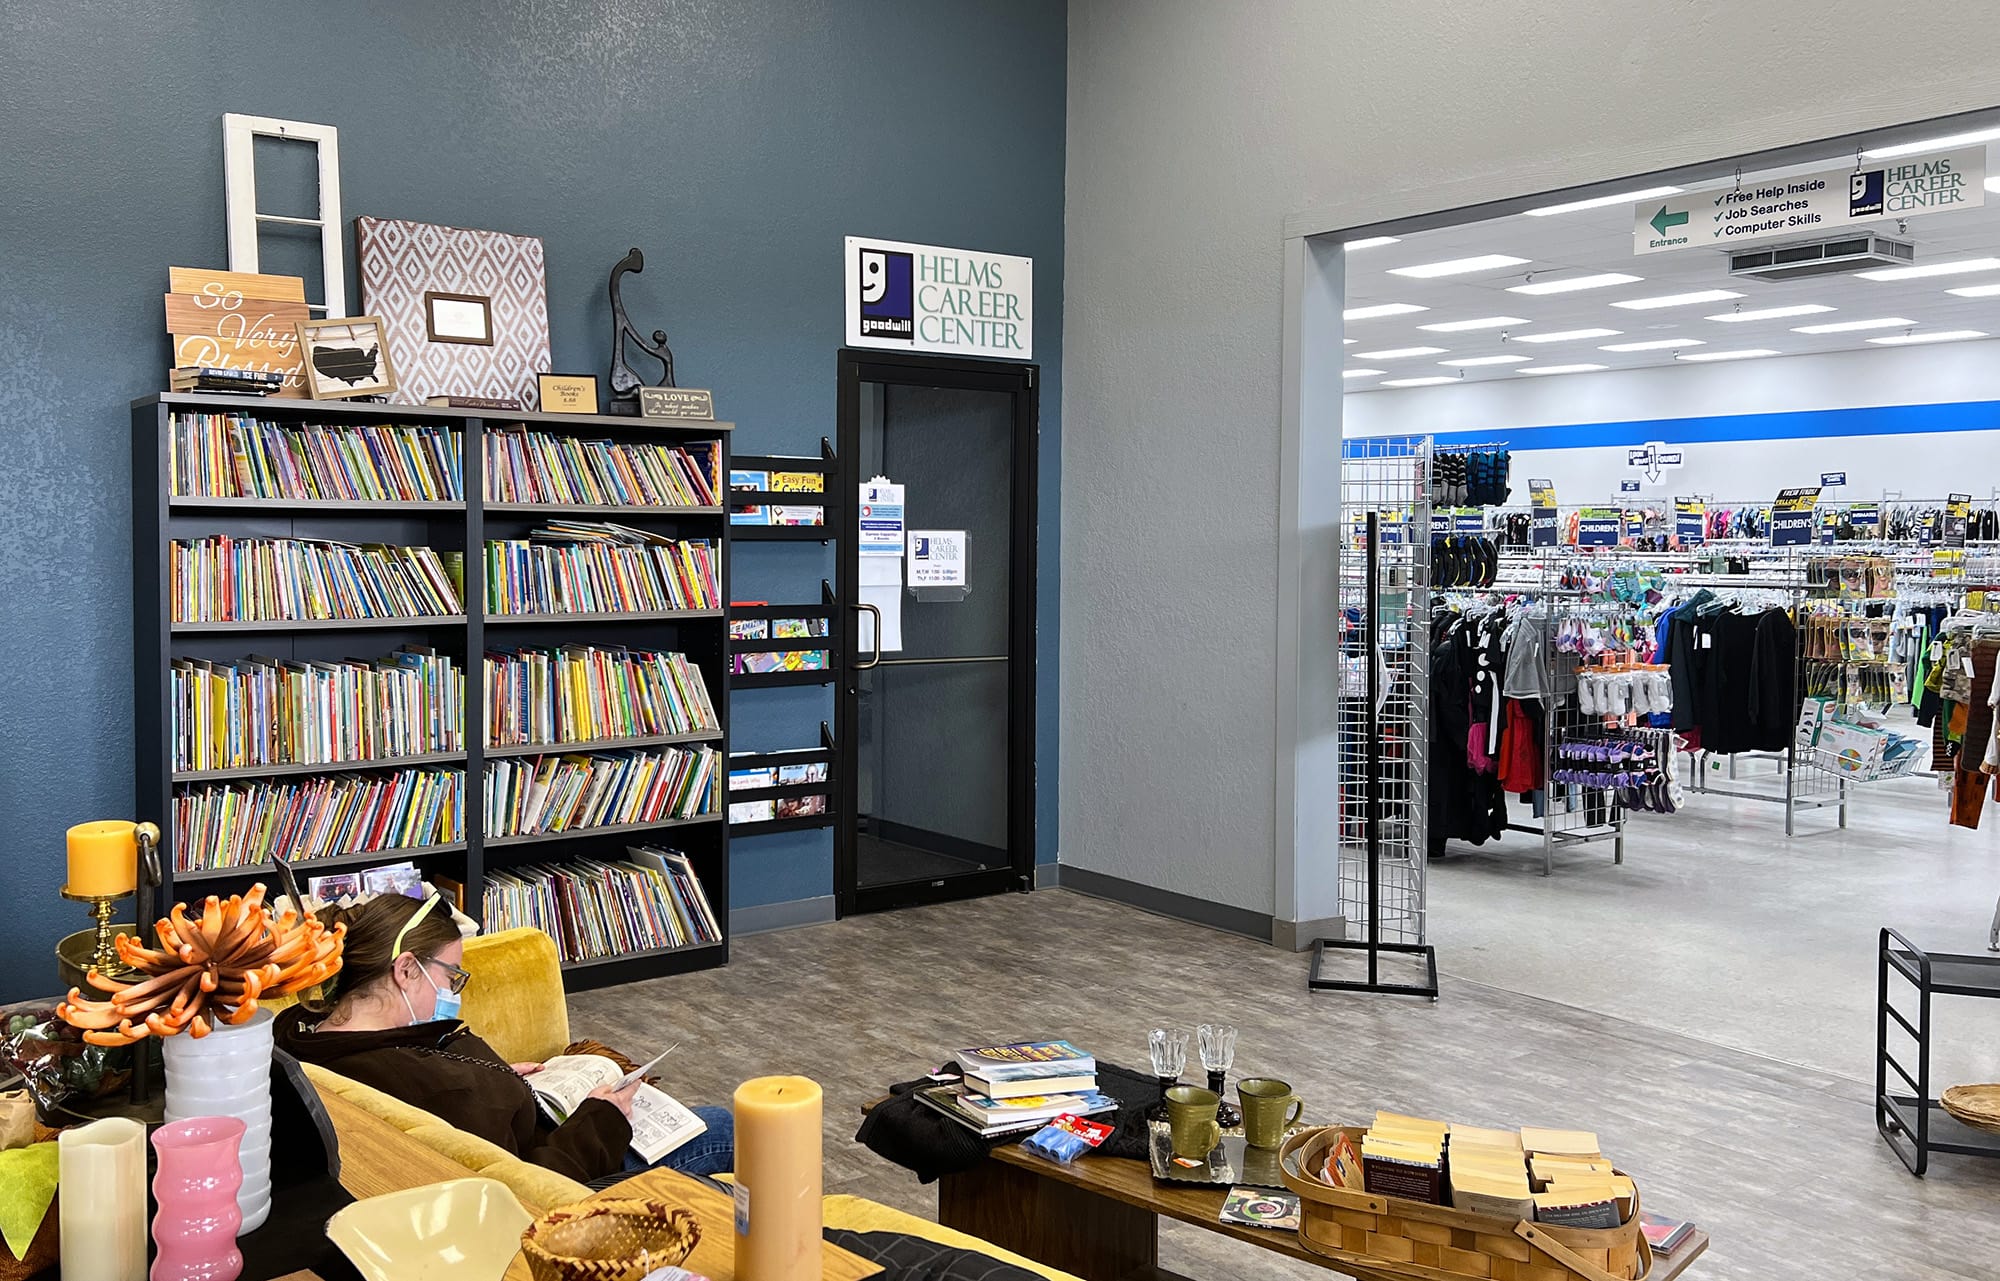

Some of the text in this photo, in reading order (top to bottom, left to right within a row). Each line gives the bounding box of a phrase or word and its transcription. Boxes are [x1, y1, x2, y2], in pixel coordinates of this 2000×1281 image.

[1888, 159, 1950, 182] HELMS
[1726, 180, 1825, 204] Free Help Inside
[1887, 172, 1967, 197] CAREER
[1887, 188, 1966, 211] CENTER
[1725, 199, 1809, 220] Job Searches
[1725, 213, 1822, 236] Computer Skills
[1649, 237, 1688, 248] Entrance
[919, 254, 1003, 289] HELMS
[918, 284, 1024, 321] CAREER
[863, 318, 912, 334] goodwill
[919, 315, 1024, 350] CENTER
[217, 313, 298, 358] Very
[663, 393, 690, 402] LOVE
[782, 475, 816, 485] Easy Fun
[783, 484, 816, 493] Crafts
[1580, 524, 1619, 533] CHILDREN'S
[1773, 518, 1812, 530] CHILDREN'S
[930, 537, 953, 545] HELMS
[930, 545, 959, 553] CAREER
[930, 553, 958, 561] CENTER
